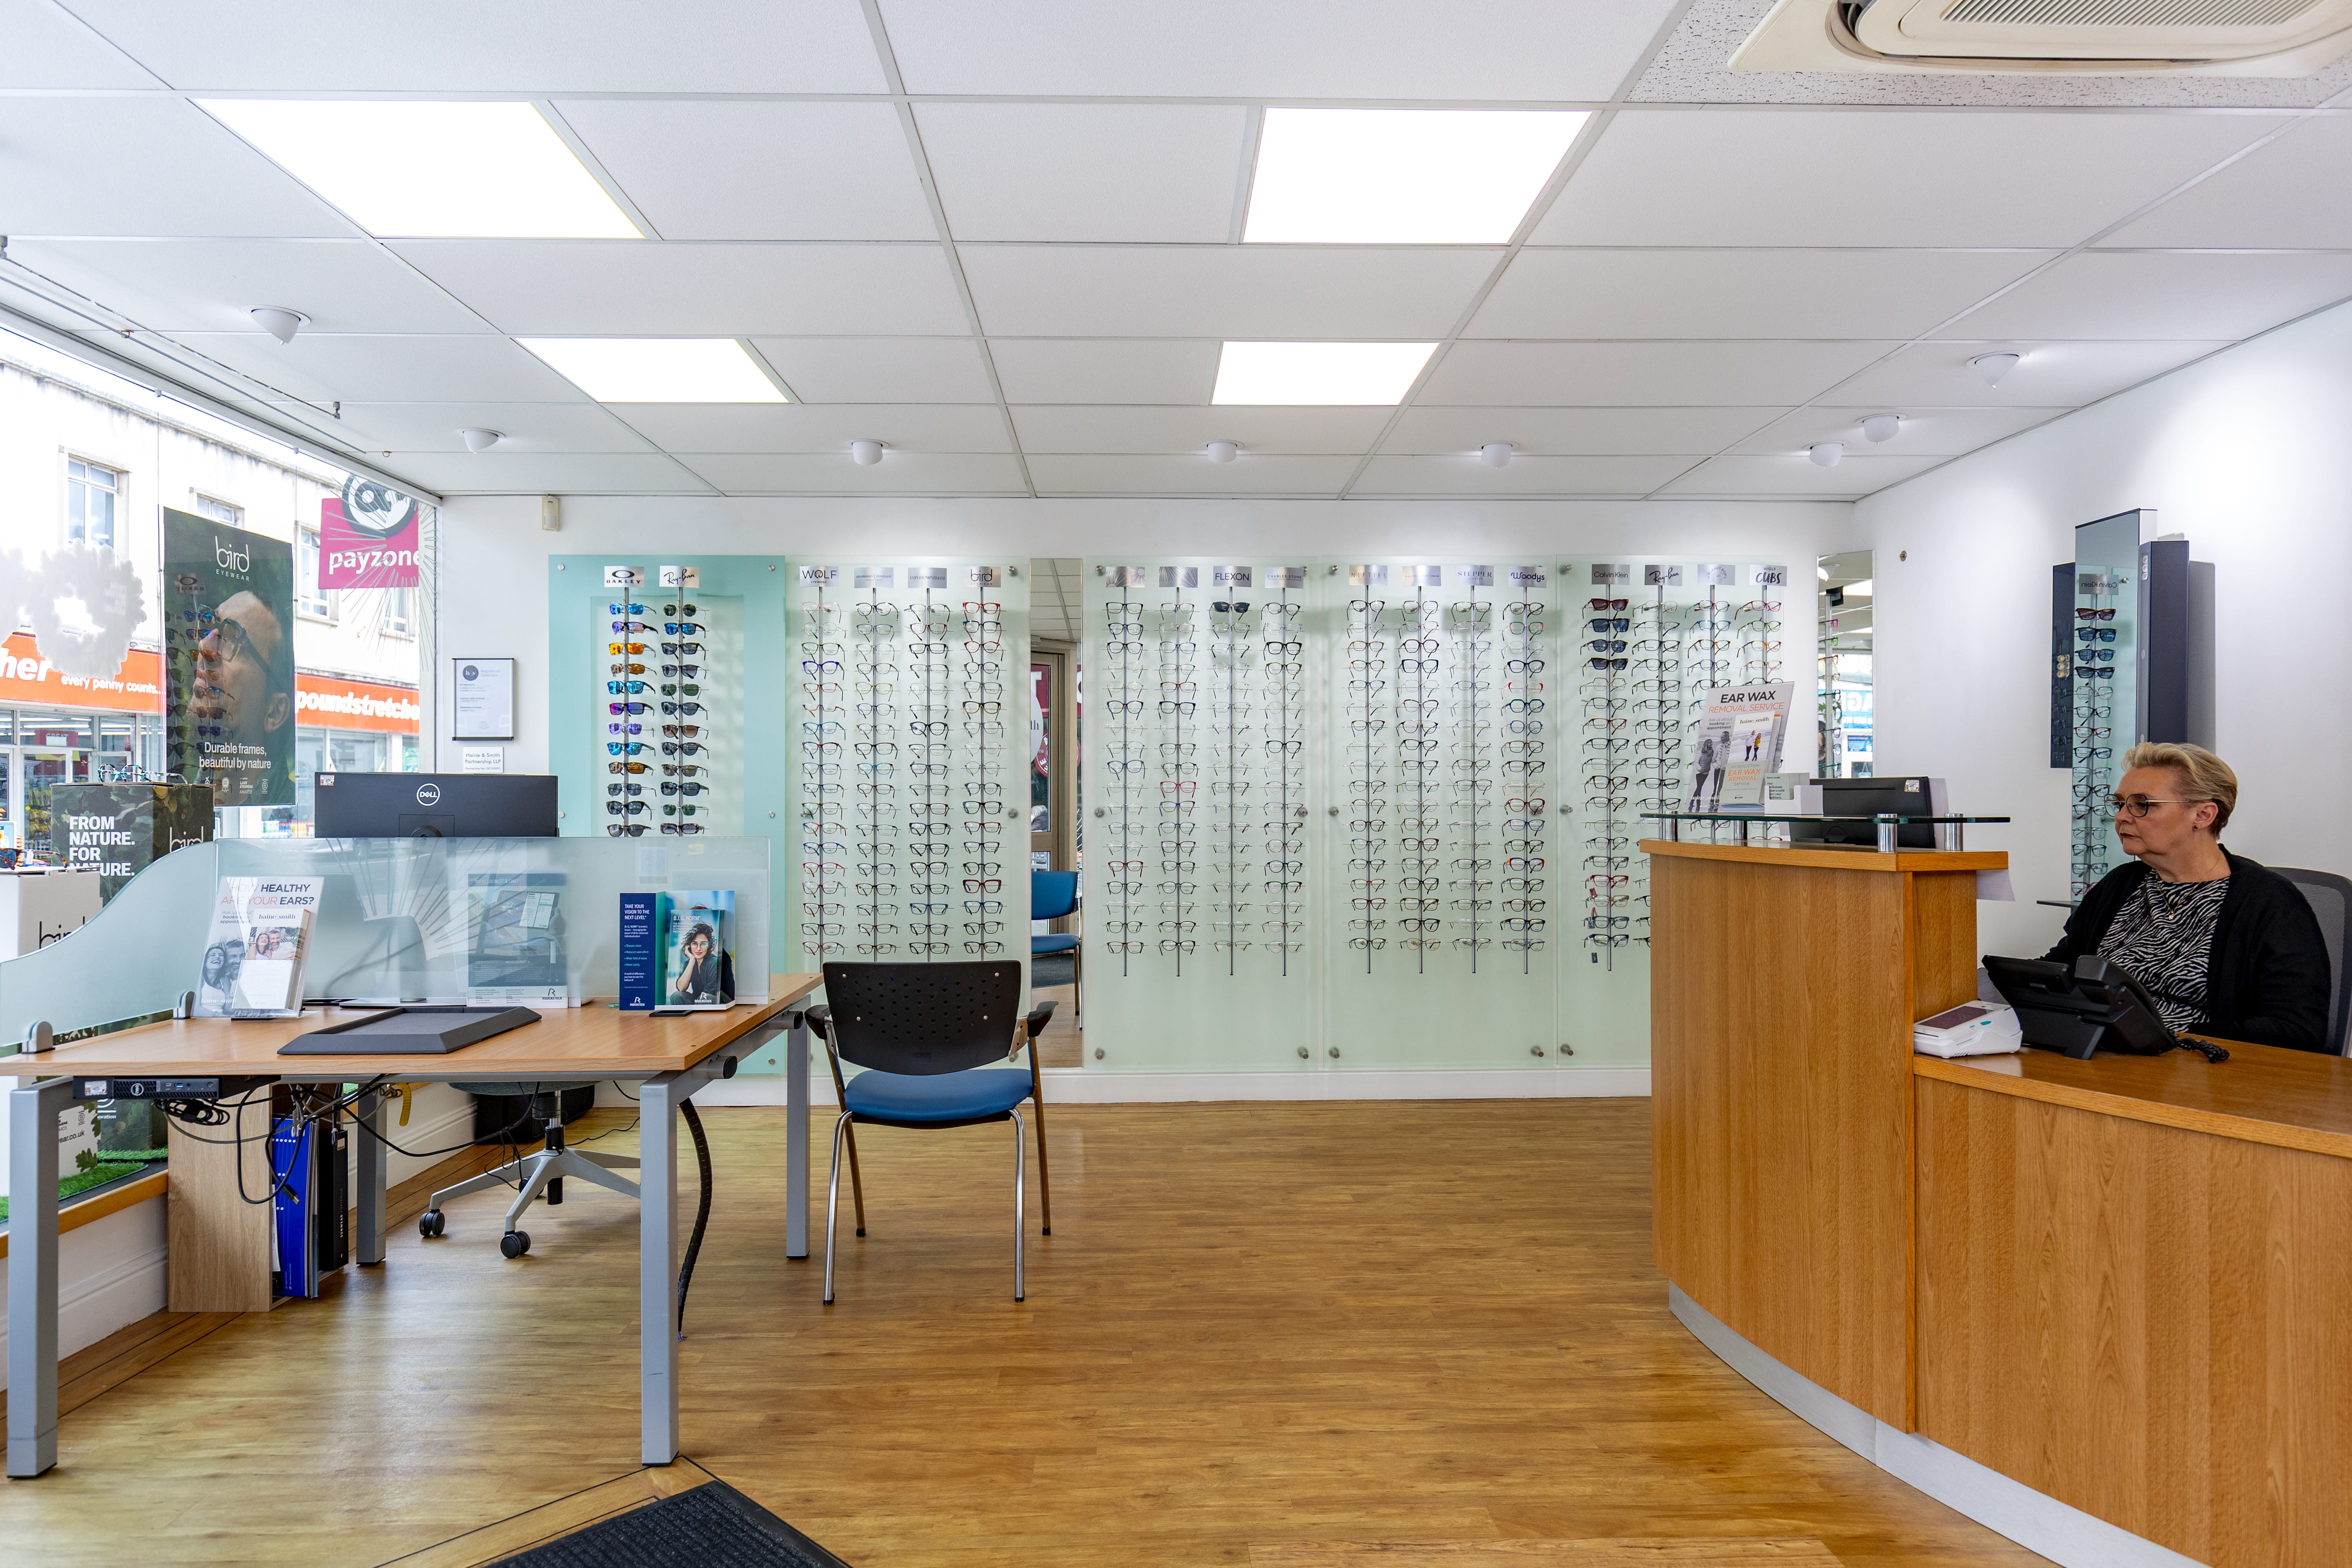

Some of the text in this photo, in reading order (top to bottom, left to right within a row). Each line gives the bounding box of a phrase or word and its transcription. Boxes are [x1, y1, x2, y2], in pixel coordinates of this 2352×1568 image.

[215, 536, 250, 572] bird
[216, 569, 249, 581] EYEWEAR
[802, 570, 837, 579] WOLF
[971, 568, 993, 582] bird
[1511, 572, 1545, 582] Woodys
[1649, 567, 1679, 583] Ray-Ban
[1756, 572, 1782, 584] CUBS
[61, 675, 124, 693] every penny
[1720, 690, 1777, 703] EAR WAX
[1708, 702, 1785, 713] REMOVAL SERVICE
[204, 741, 267, 757] Durable frames,
[199, 755, 271, 771] beautiful by nature
[69, 816, 115, 830] FROM
[69, 831, 135, 845] NATURE.
[69, 847, 101, 861] FOR
[69, 863, 135, 876] URE.
[261, 884, 311, 893] HEALTHY
[220, 896, 315, 905] ARE YOUR EARS?
